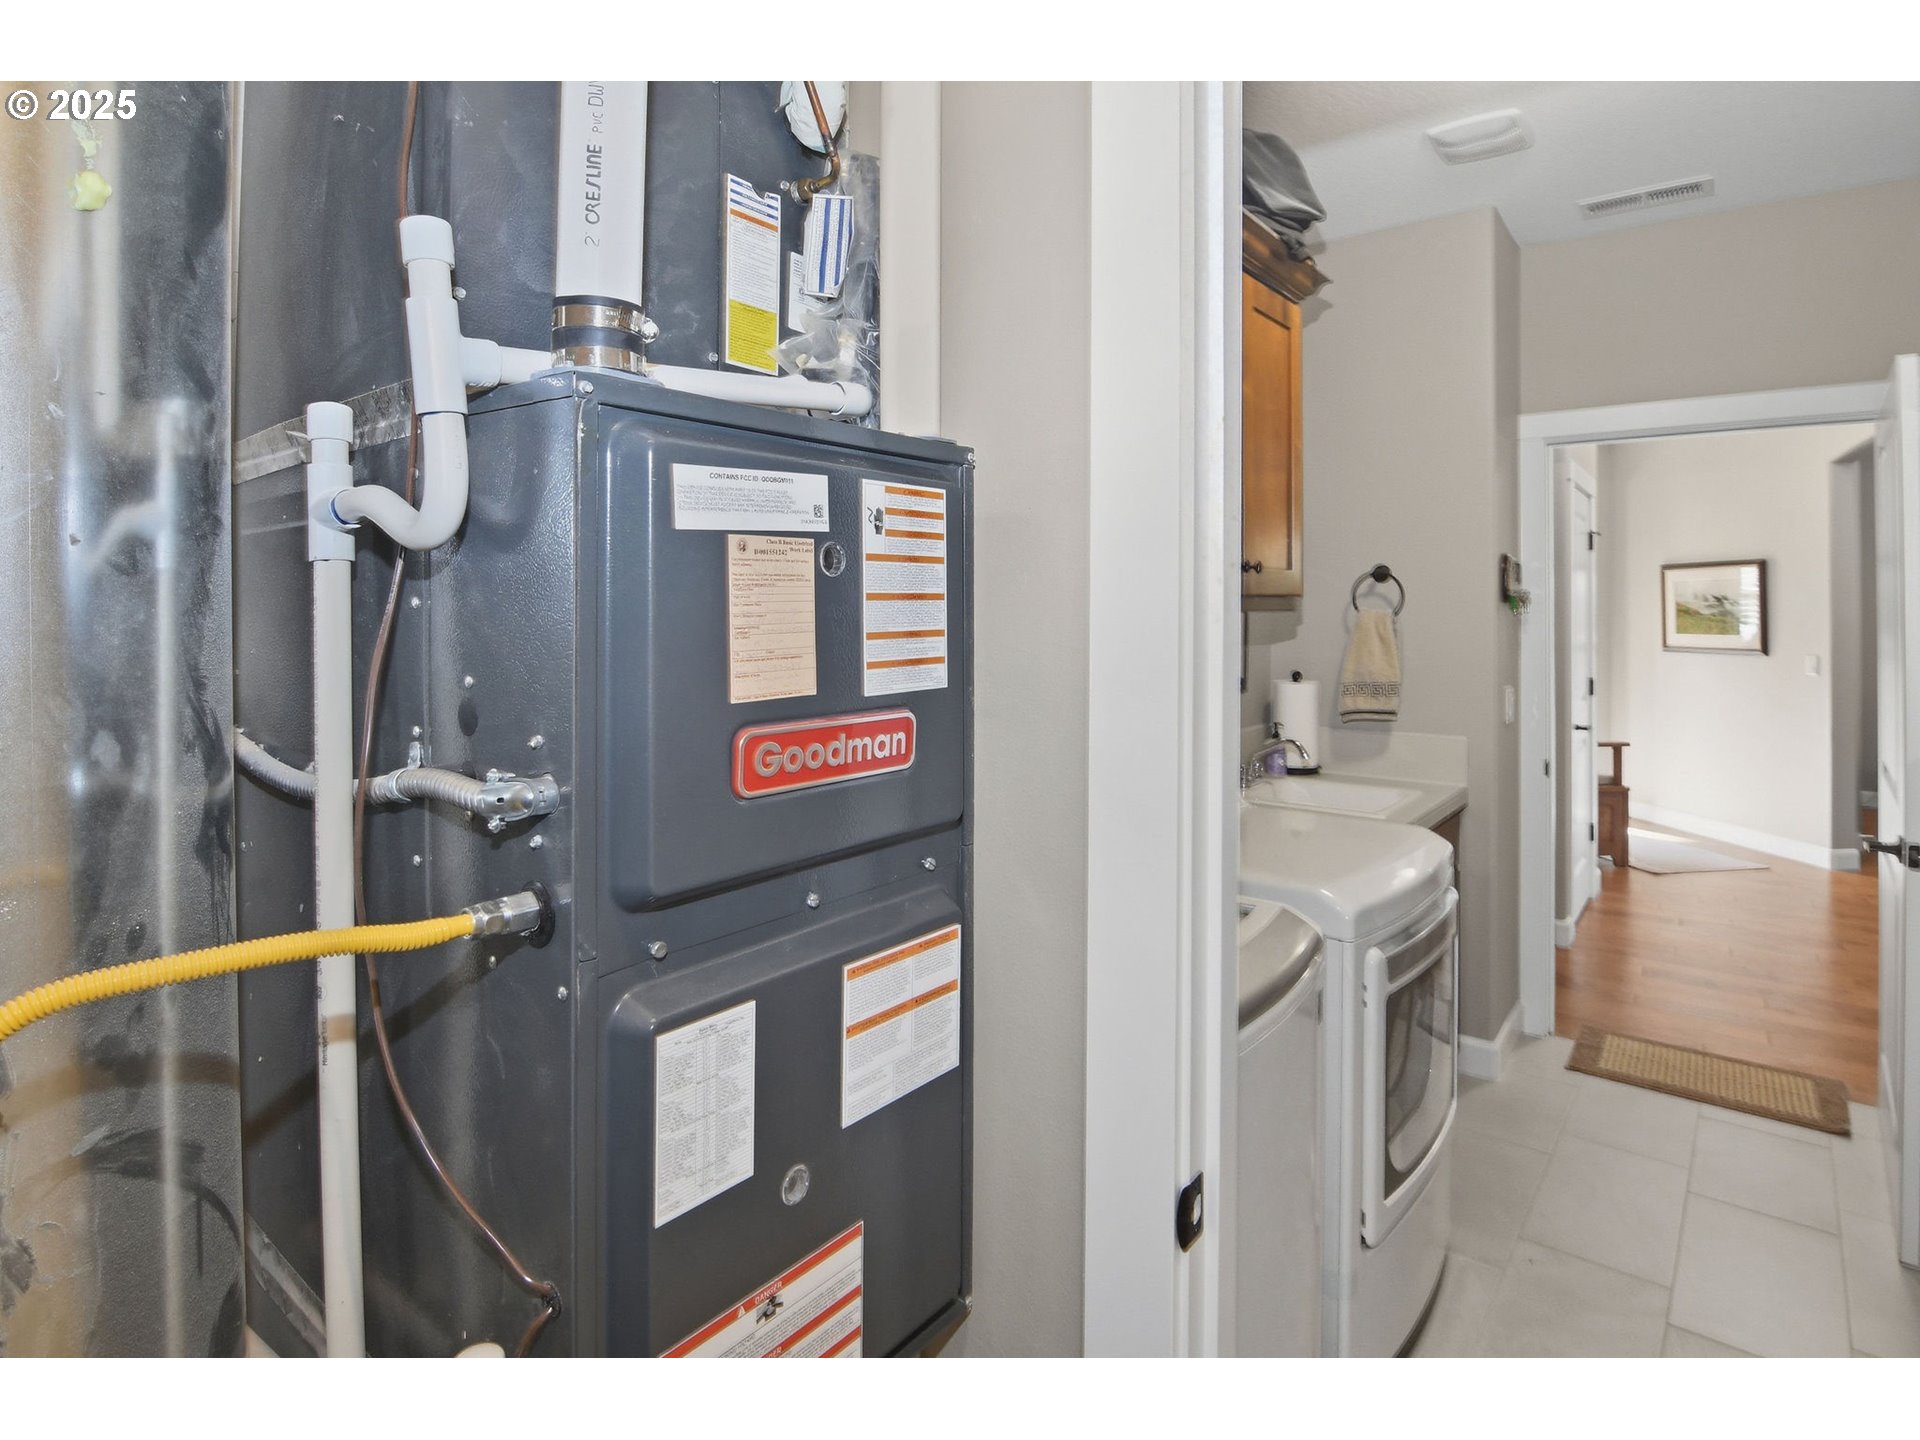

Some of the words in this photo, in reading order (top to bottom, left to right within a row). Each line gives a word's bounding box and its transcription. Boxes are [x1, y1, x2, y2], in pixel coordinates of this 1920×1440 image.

[591, 112, 604, 133] PVC
[584, 144, 602, 225] CRESLINE
[709, 472, 739, 480] CONTAINS
[754, 731, 906, 777] Goodman
[755, 1281, 782, 1303] DANGER
